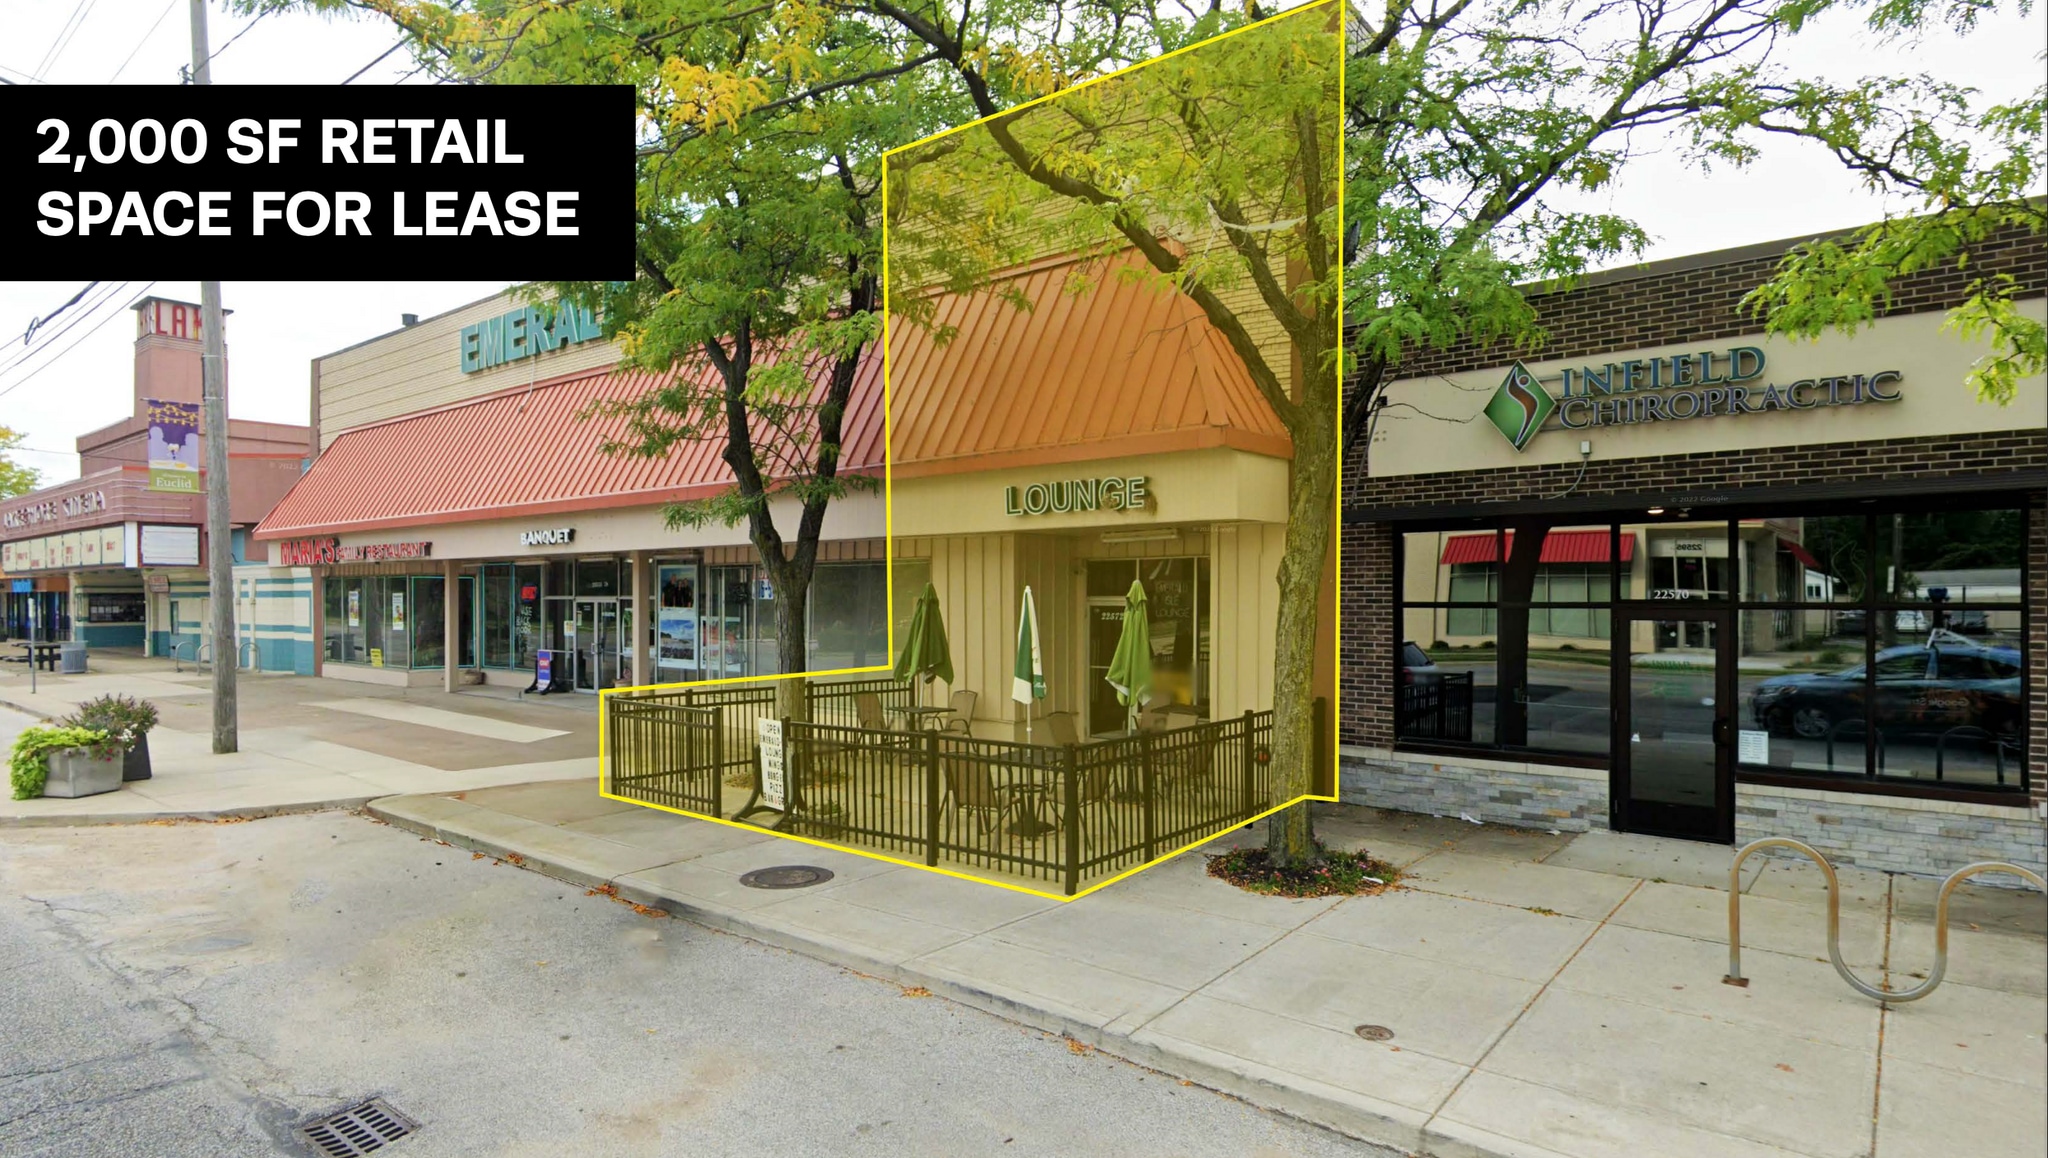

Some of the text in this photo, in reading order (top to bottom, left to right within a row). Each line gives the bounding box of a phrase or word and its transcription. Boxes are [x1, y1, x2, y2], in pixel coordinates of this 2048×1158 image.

[155, 300, 203, 342] LAK
[461, 286, 608, 373] EMERAL
[1561, 346, 1766, 398] INFIELD
[1559, 370, 1902, 429] CHIROPRACTIC
[156, 477, 192, 488] Euclid
[1005, 476, 1147, 516] LOUNGE
[520, 528, 571, 545] BANQUET
[280, 537, 428, 565] MARIA'S FAMILY RESTAURANT
[1654, 590, 1690, 600] 22570
[766, 724, 780, 734] OPEN
[765, 747, 782, 759] LOUNG
[769, 782, 783, 794] PIZZ
